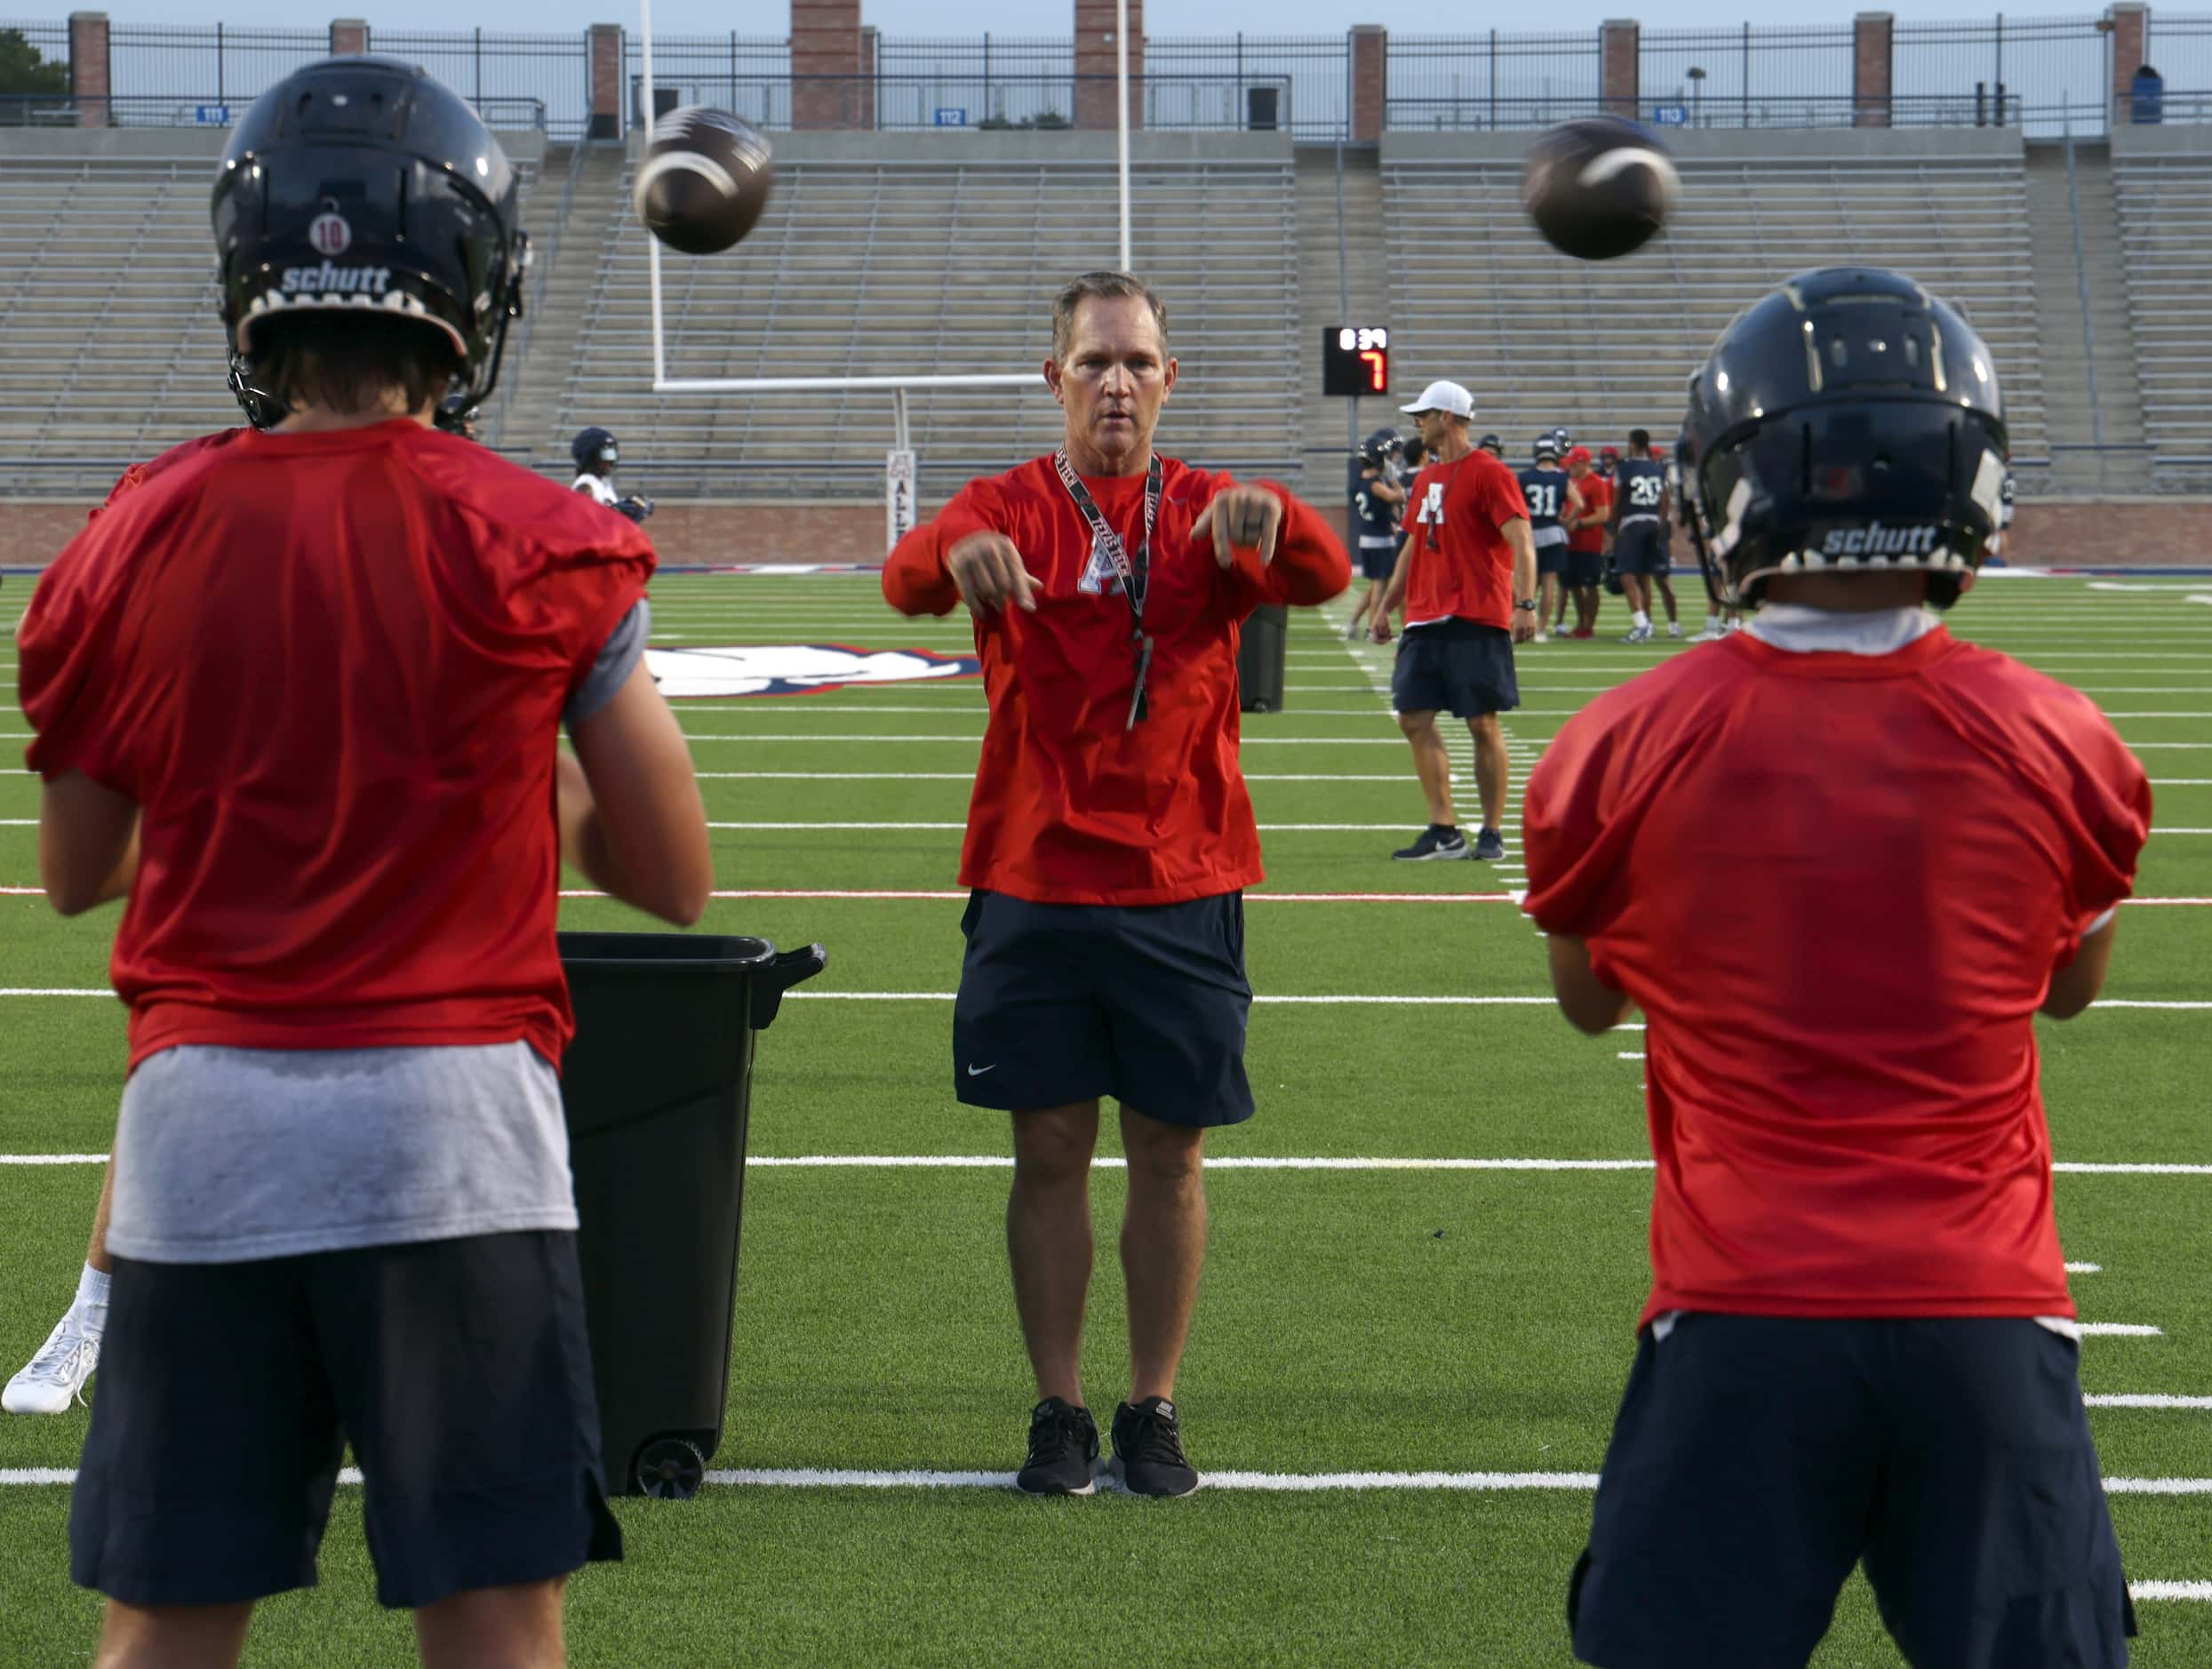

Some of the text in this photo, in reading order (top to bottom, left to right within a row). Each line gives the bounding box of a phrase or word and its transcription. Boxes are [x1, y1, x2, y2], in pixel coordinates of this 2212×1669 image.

[940, 110, 961, 124] 112
[1660, 108, 1680, 123] 113
[318, 220, 343, 250] 10
[281, 260, 390, 292] schutt
[1360, 351, 1384, 390] 7
[1525, 484, 1556, 515] 31
[1630, 476, 1662, 505] 20
[1091, 516, 1117, 547] TEXAS
[1823, 521, 1936, 554] schutt
